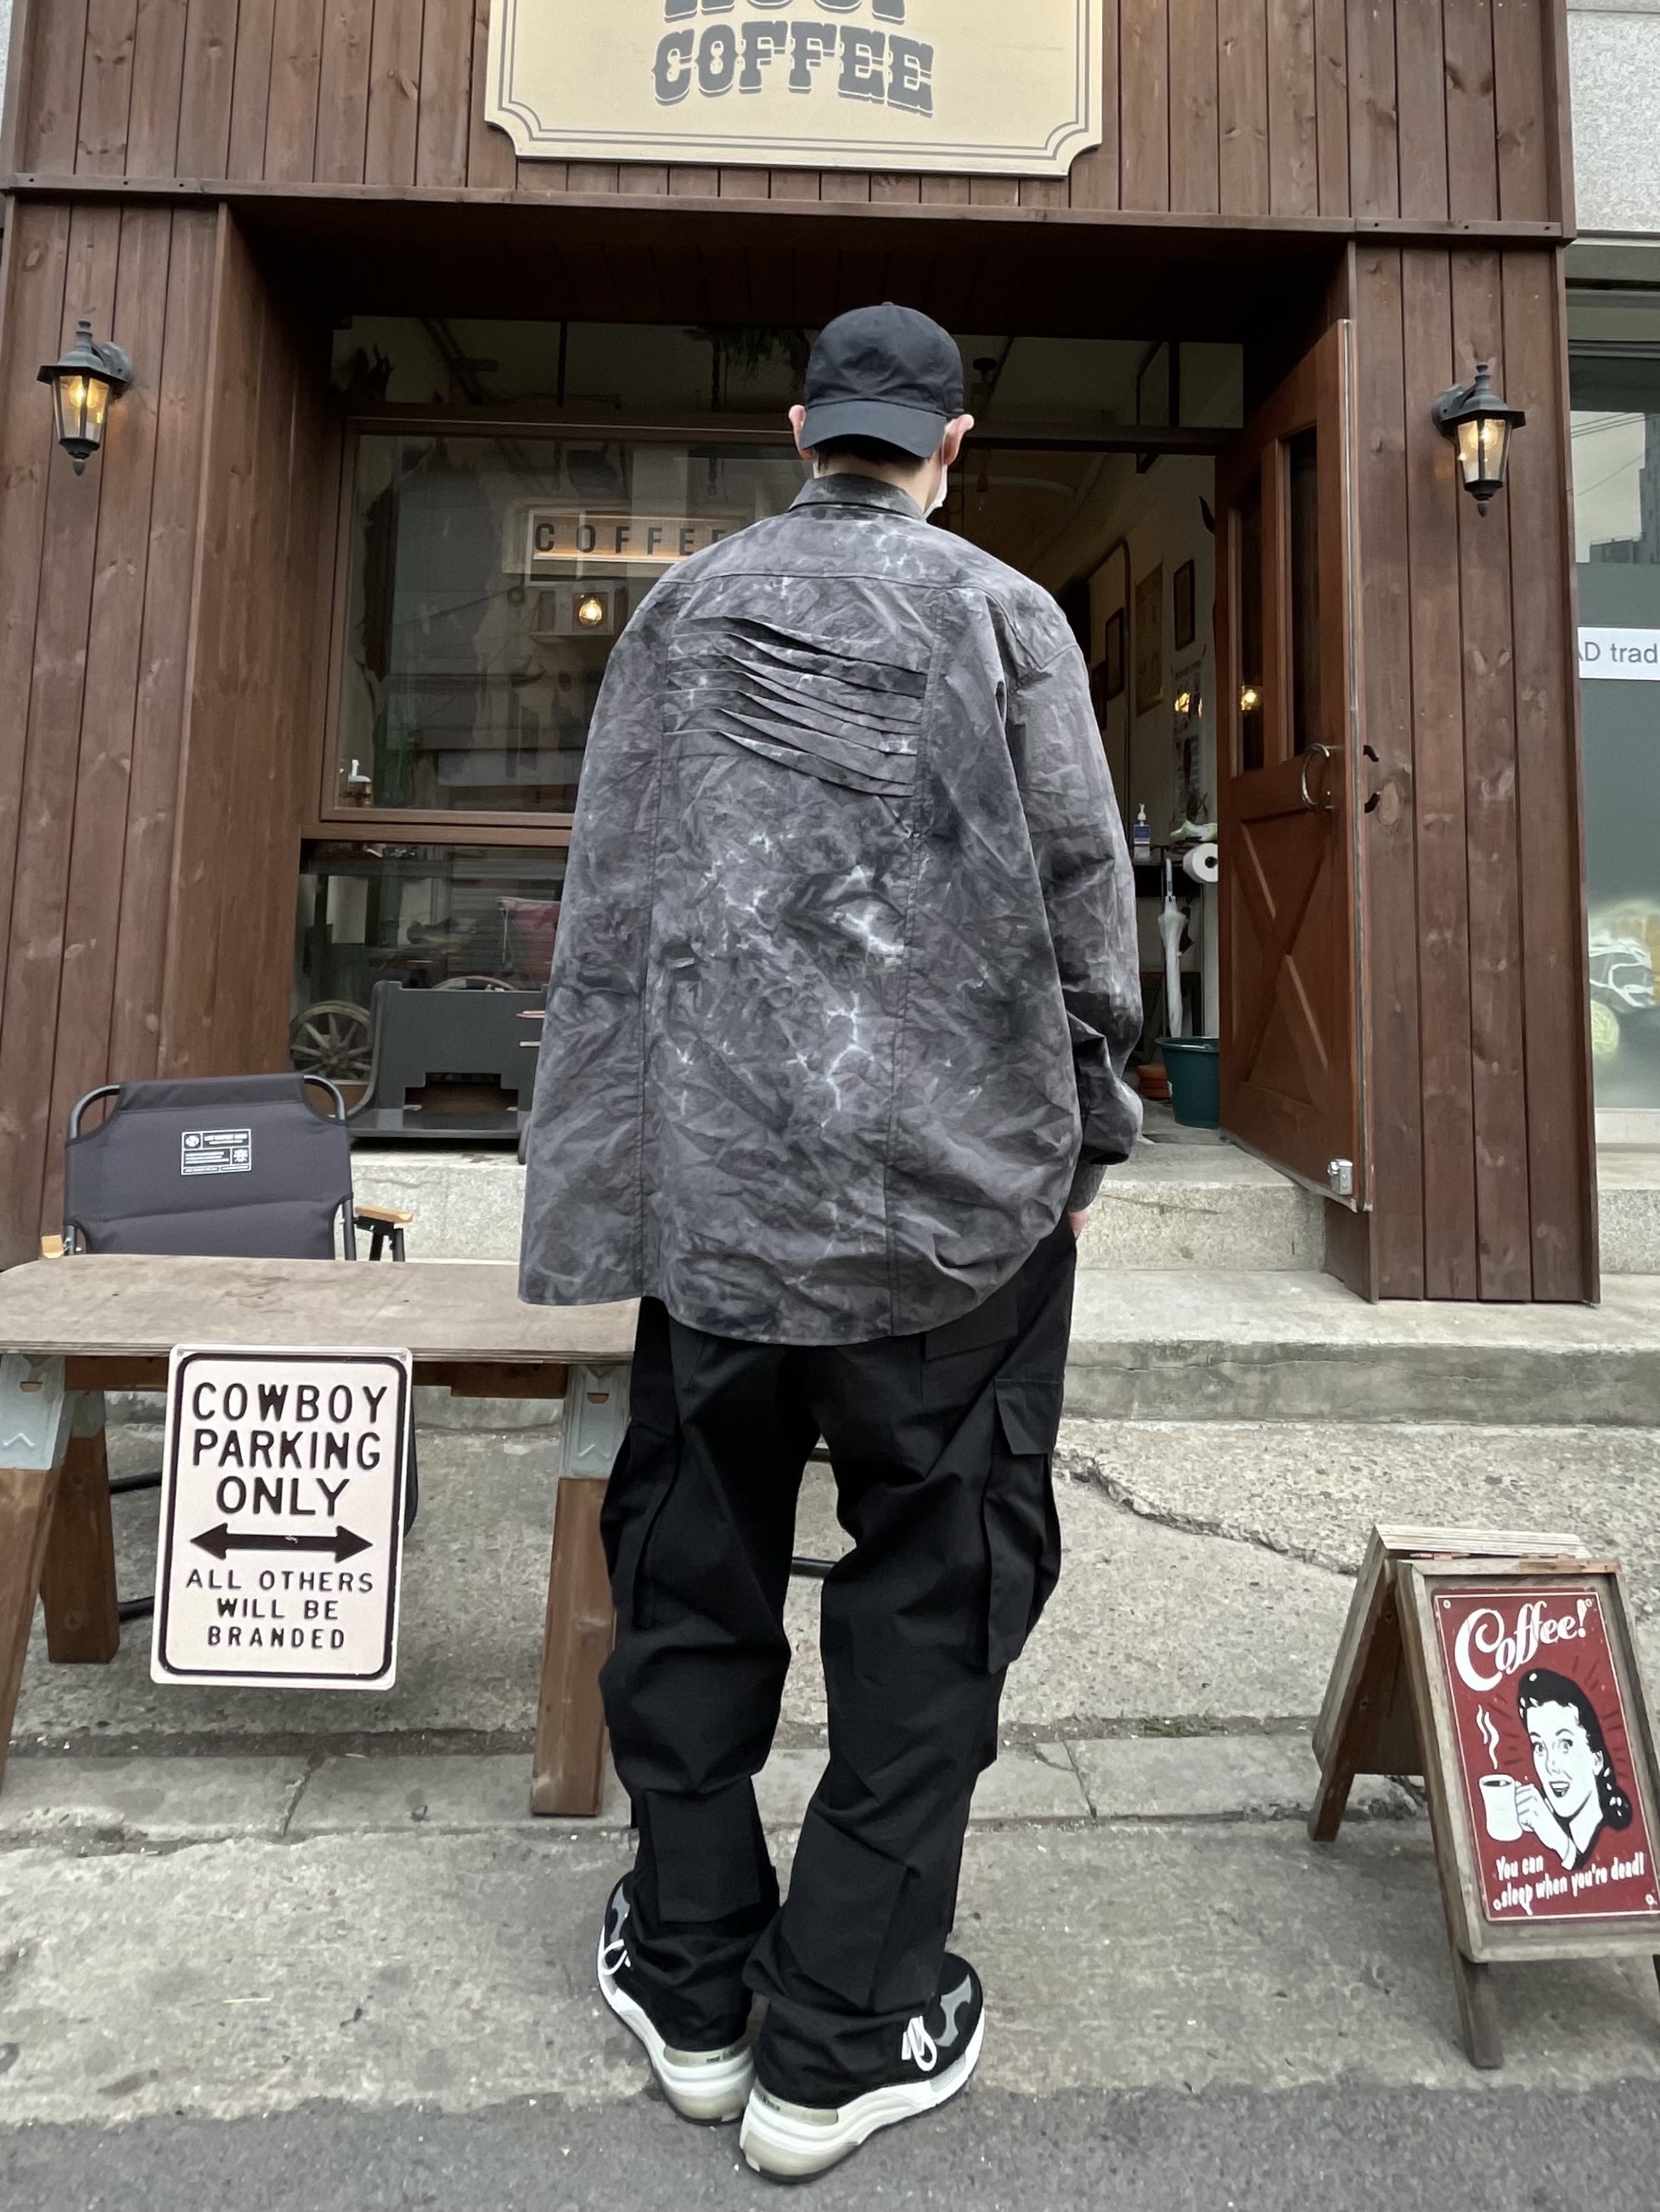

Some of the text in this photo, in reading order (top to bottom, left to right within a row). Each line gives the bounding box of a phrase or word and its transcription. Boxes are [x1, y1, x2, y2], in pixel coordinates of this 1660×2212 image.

[651, 20, 933, 118] COFFEE
[1578, 641, 1601, 661] D
[192, 1382, 388, 1424] COWBOY
[193, 1428, 381, 1471] PARKING
[216, 1475, 351, 1517] ONLY
[186, 1568, 374, 1593] ALL OTHERS
[217, 1597, 339, 1620] WILL BE
[207, 1625, 345, 1649] BRANDED
[1455, 1598, 1587, 1691] Coffee!
[1496, 1855, 1544, 1881] You can
[1501, 1851, 1645, 1916] sleep when you're dead!
